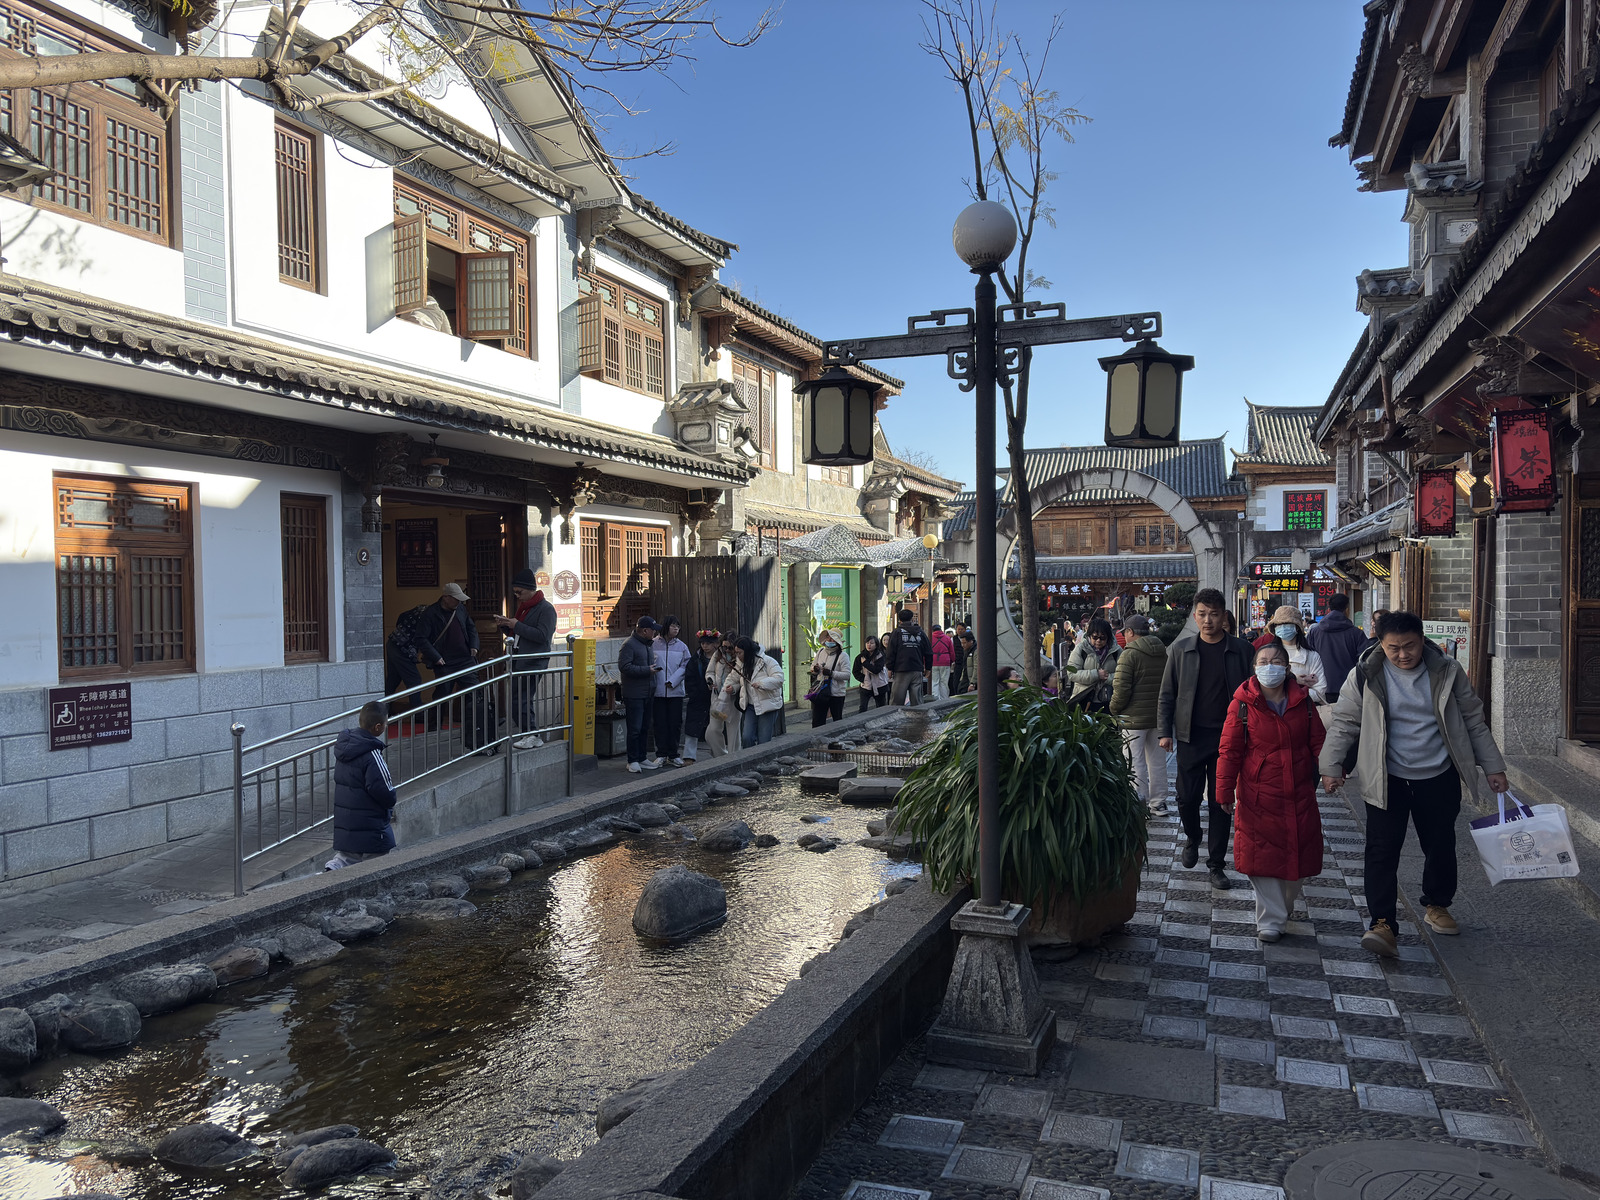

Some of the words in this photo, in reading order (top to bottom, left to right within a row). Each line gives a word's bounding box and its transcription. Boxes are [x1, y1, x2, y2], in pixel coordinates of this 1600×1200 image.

[1507, 445, 1549, 480] 茶
[1288, 494, 1322, 502] 民族品牌
[1288, 503, 1322, 511] 国货匠心
[1424, 495, 1451, 519] 茶
[361, 551, 367, 561] 2
[1262, 564, 1306, 572] 云南米
[1425, 624, 1467, 634] 当日现烘
[79, 689, 128, 703] 无障碍通道
